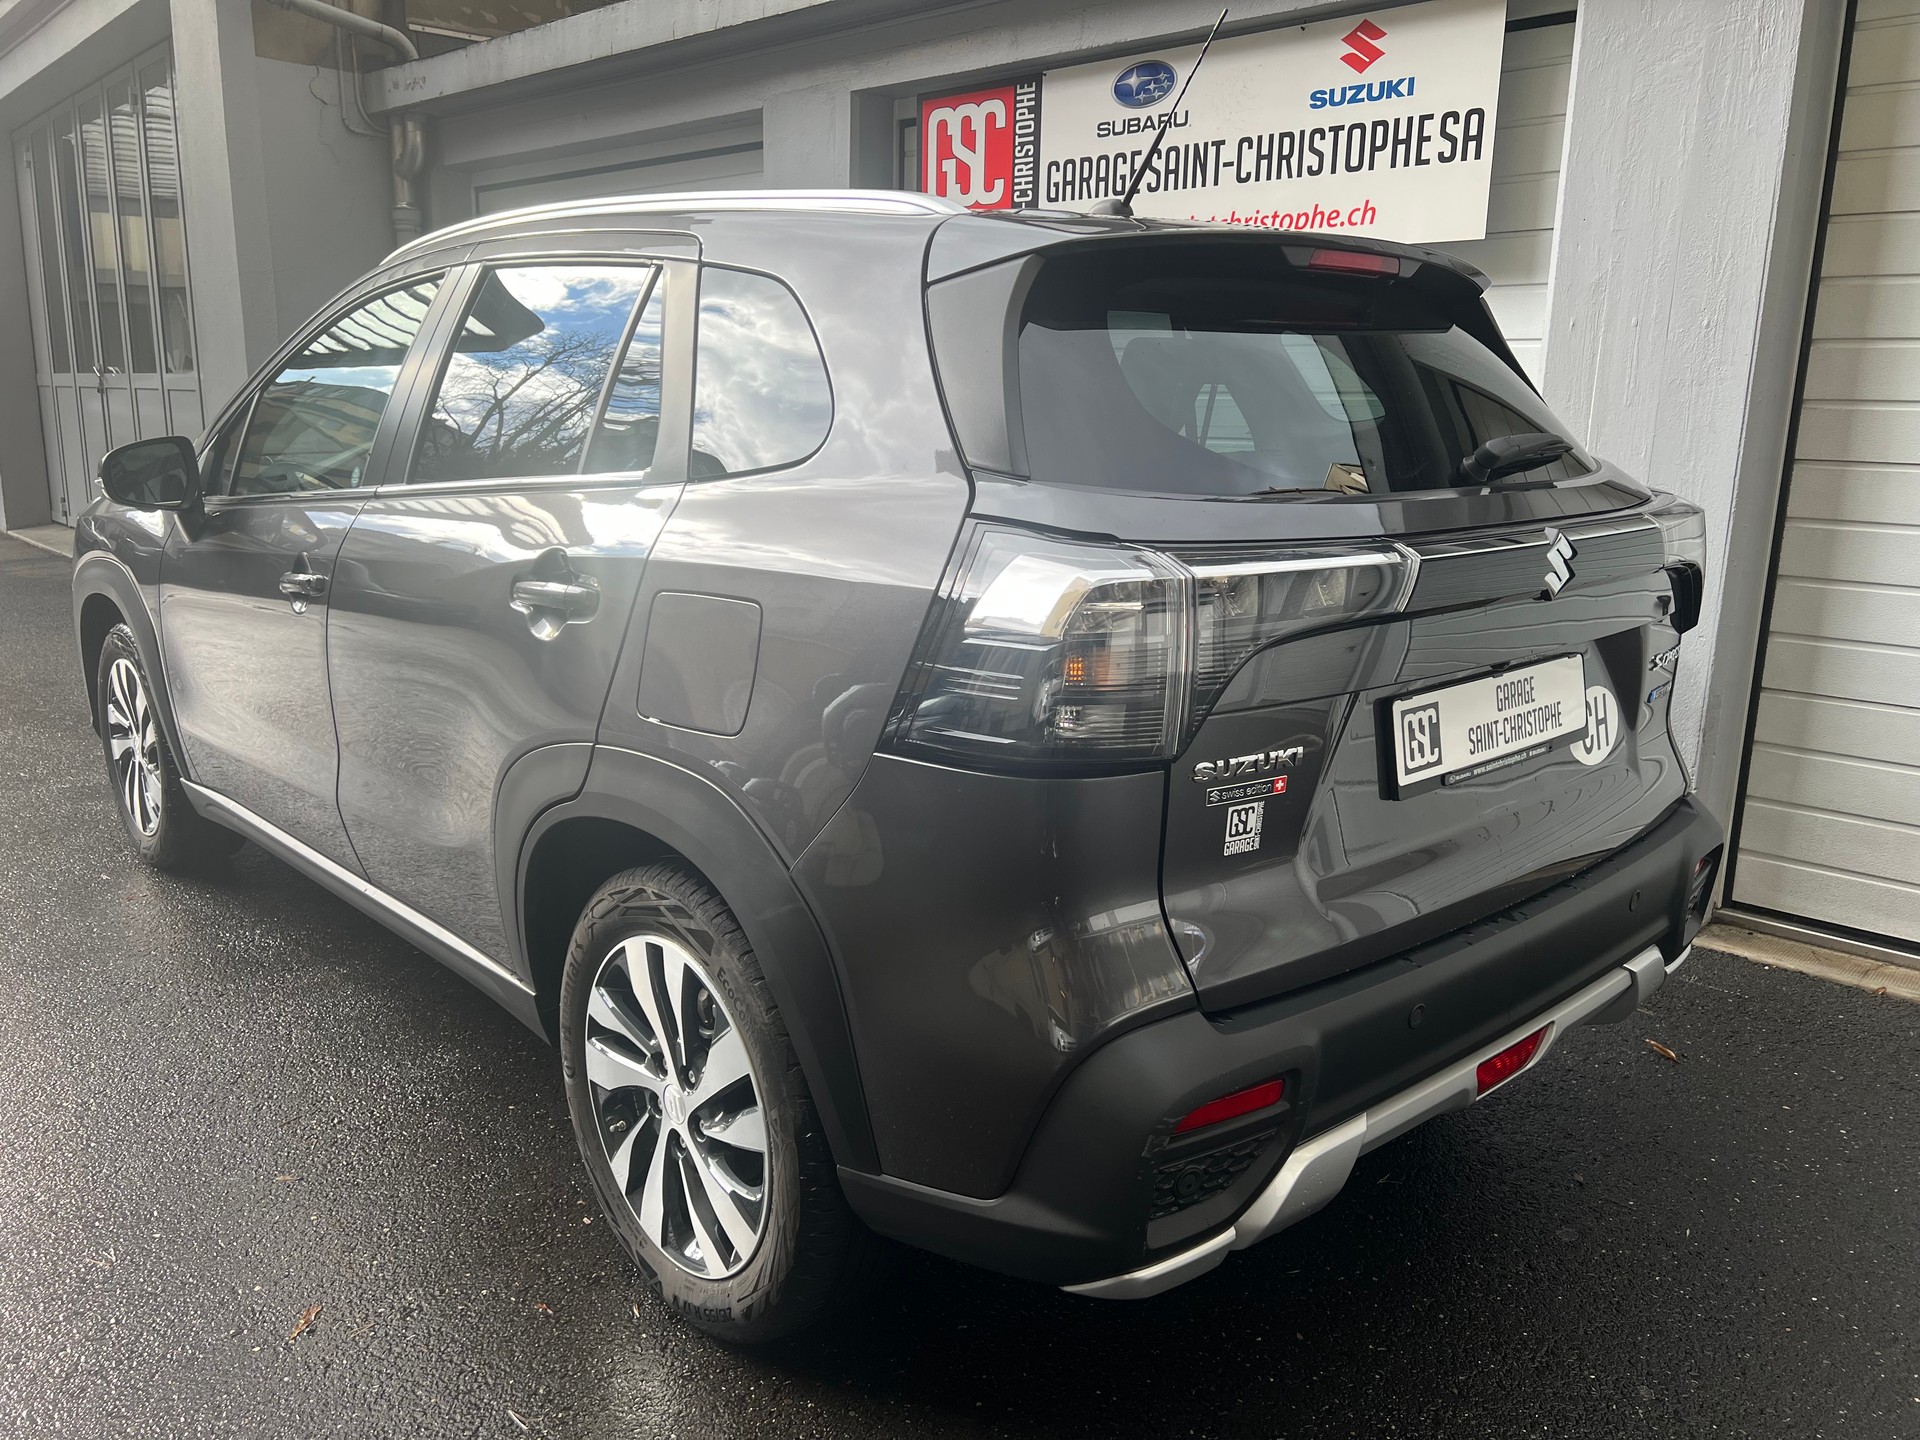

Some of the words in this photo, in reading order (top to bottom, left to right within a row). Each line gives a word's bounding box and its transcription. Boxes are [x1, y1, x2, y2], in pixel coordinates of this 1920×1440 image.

[1309, 76, 1416, 110] SUZUKI
[1096, 110, 1190, 138] SUBARU
[927, 98, 1007, 207] GSC
[1046, 149, 1143, 204] GARAGE
[1146, 112, 1435, 193] SAINT-CHRISTOPHE
[1437, 107, 1486, 164] SA
[1495, 675, 1536, 713] GARAGE
[1403, 707, 1440, 770] GSC
[1468, 700, 1563, 756] SAINT-CHRISTOPHE
[1192, 746, 1304, 784] SUZUKI
[1221, 787, 1245, 801] swiss
[1246, 783, 1272, 796] edition
[1223, 837, 1255, 857] GARAGE
